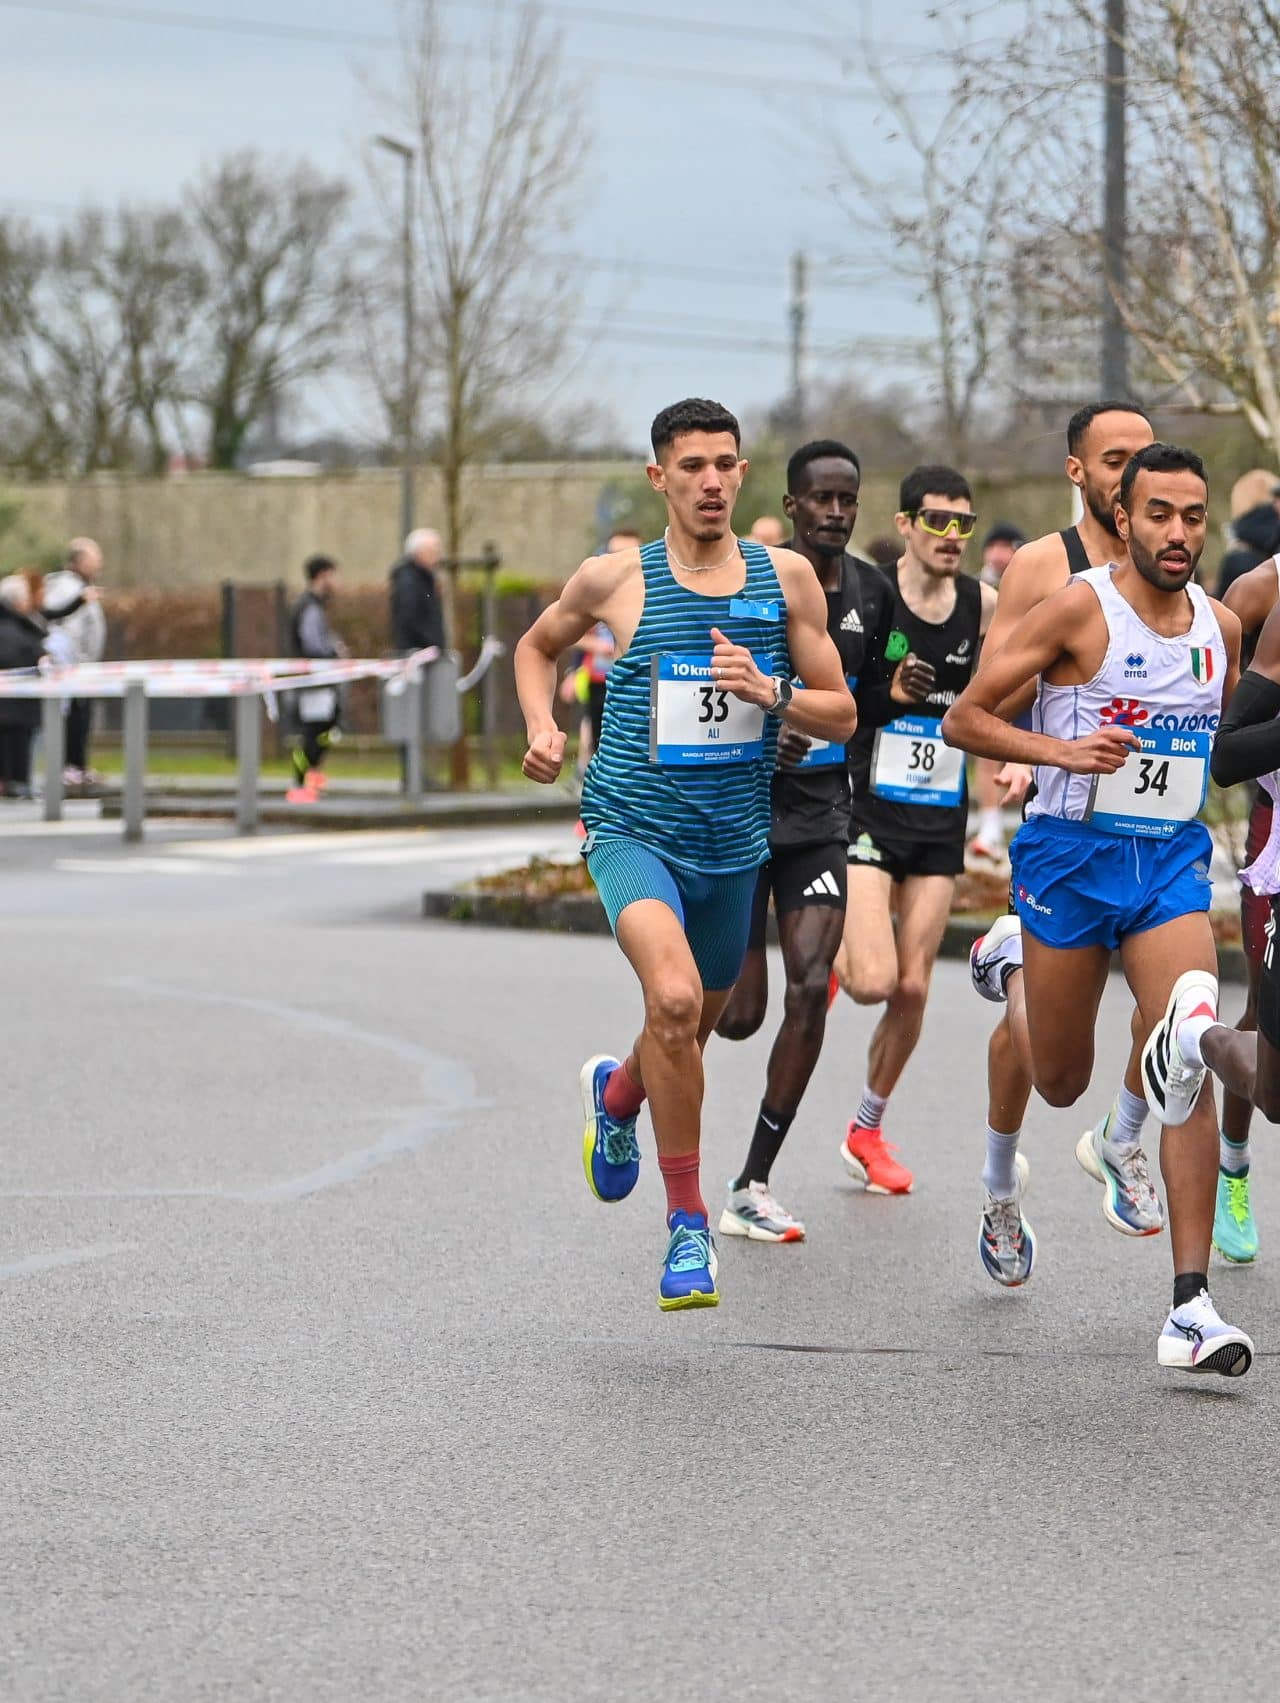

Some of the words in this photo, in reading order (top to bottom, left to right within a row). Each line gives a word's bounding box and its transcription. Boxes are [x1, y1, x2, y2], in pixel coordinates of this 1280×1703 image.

[840, 622, 864, 634] adidas
[1124, 669, 1148, 678] errea
[699, 686, 729, 723] 33
[707, 728, 720, 739] ALI
[1171, 738, 1197, 752] Blot
[908, 741, 935, 772] 38
[1134, 758, 1170, 797] 34
